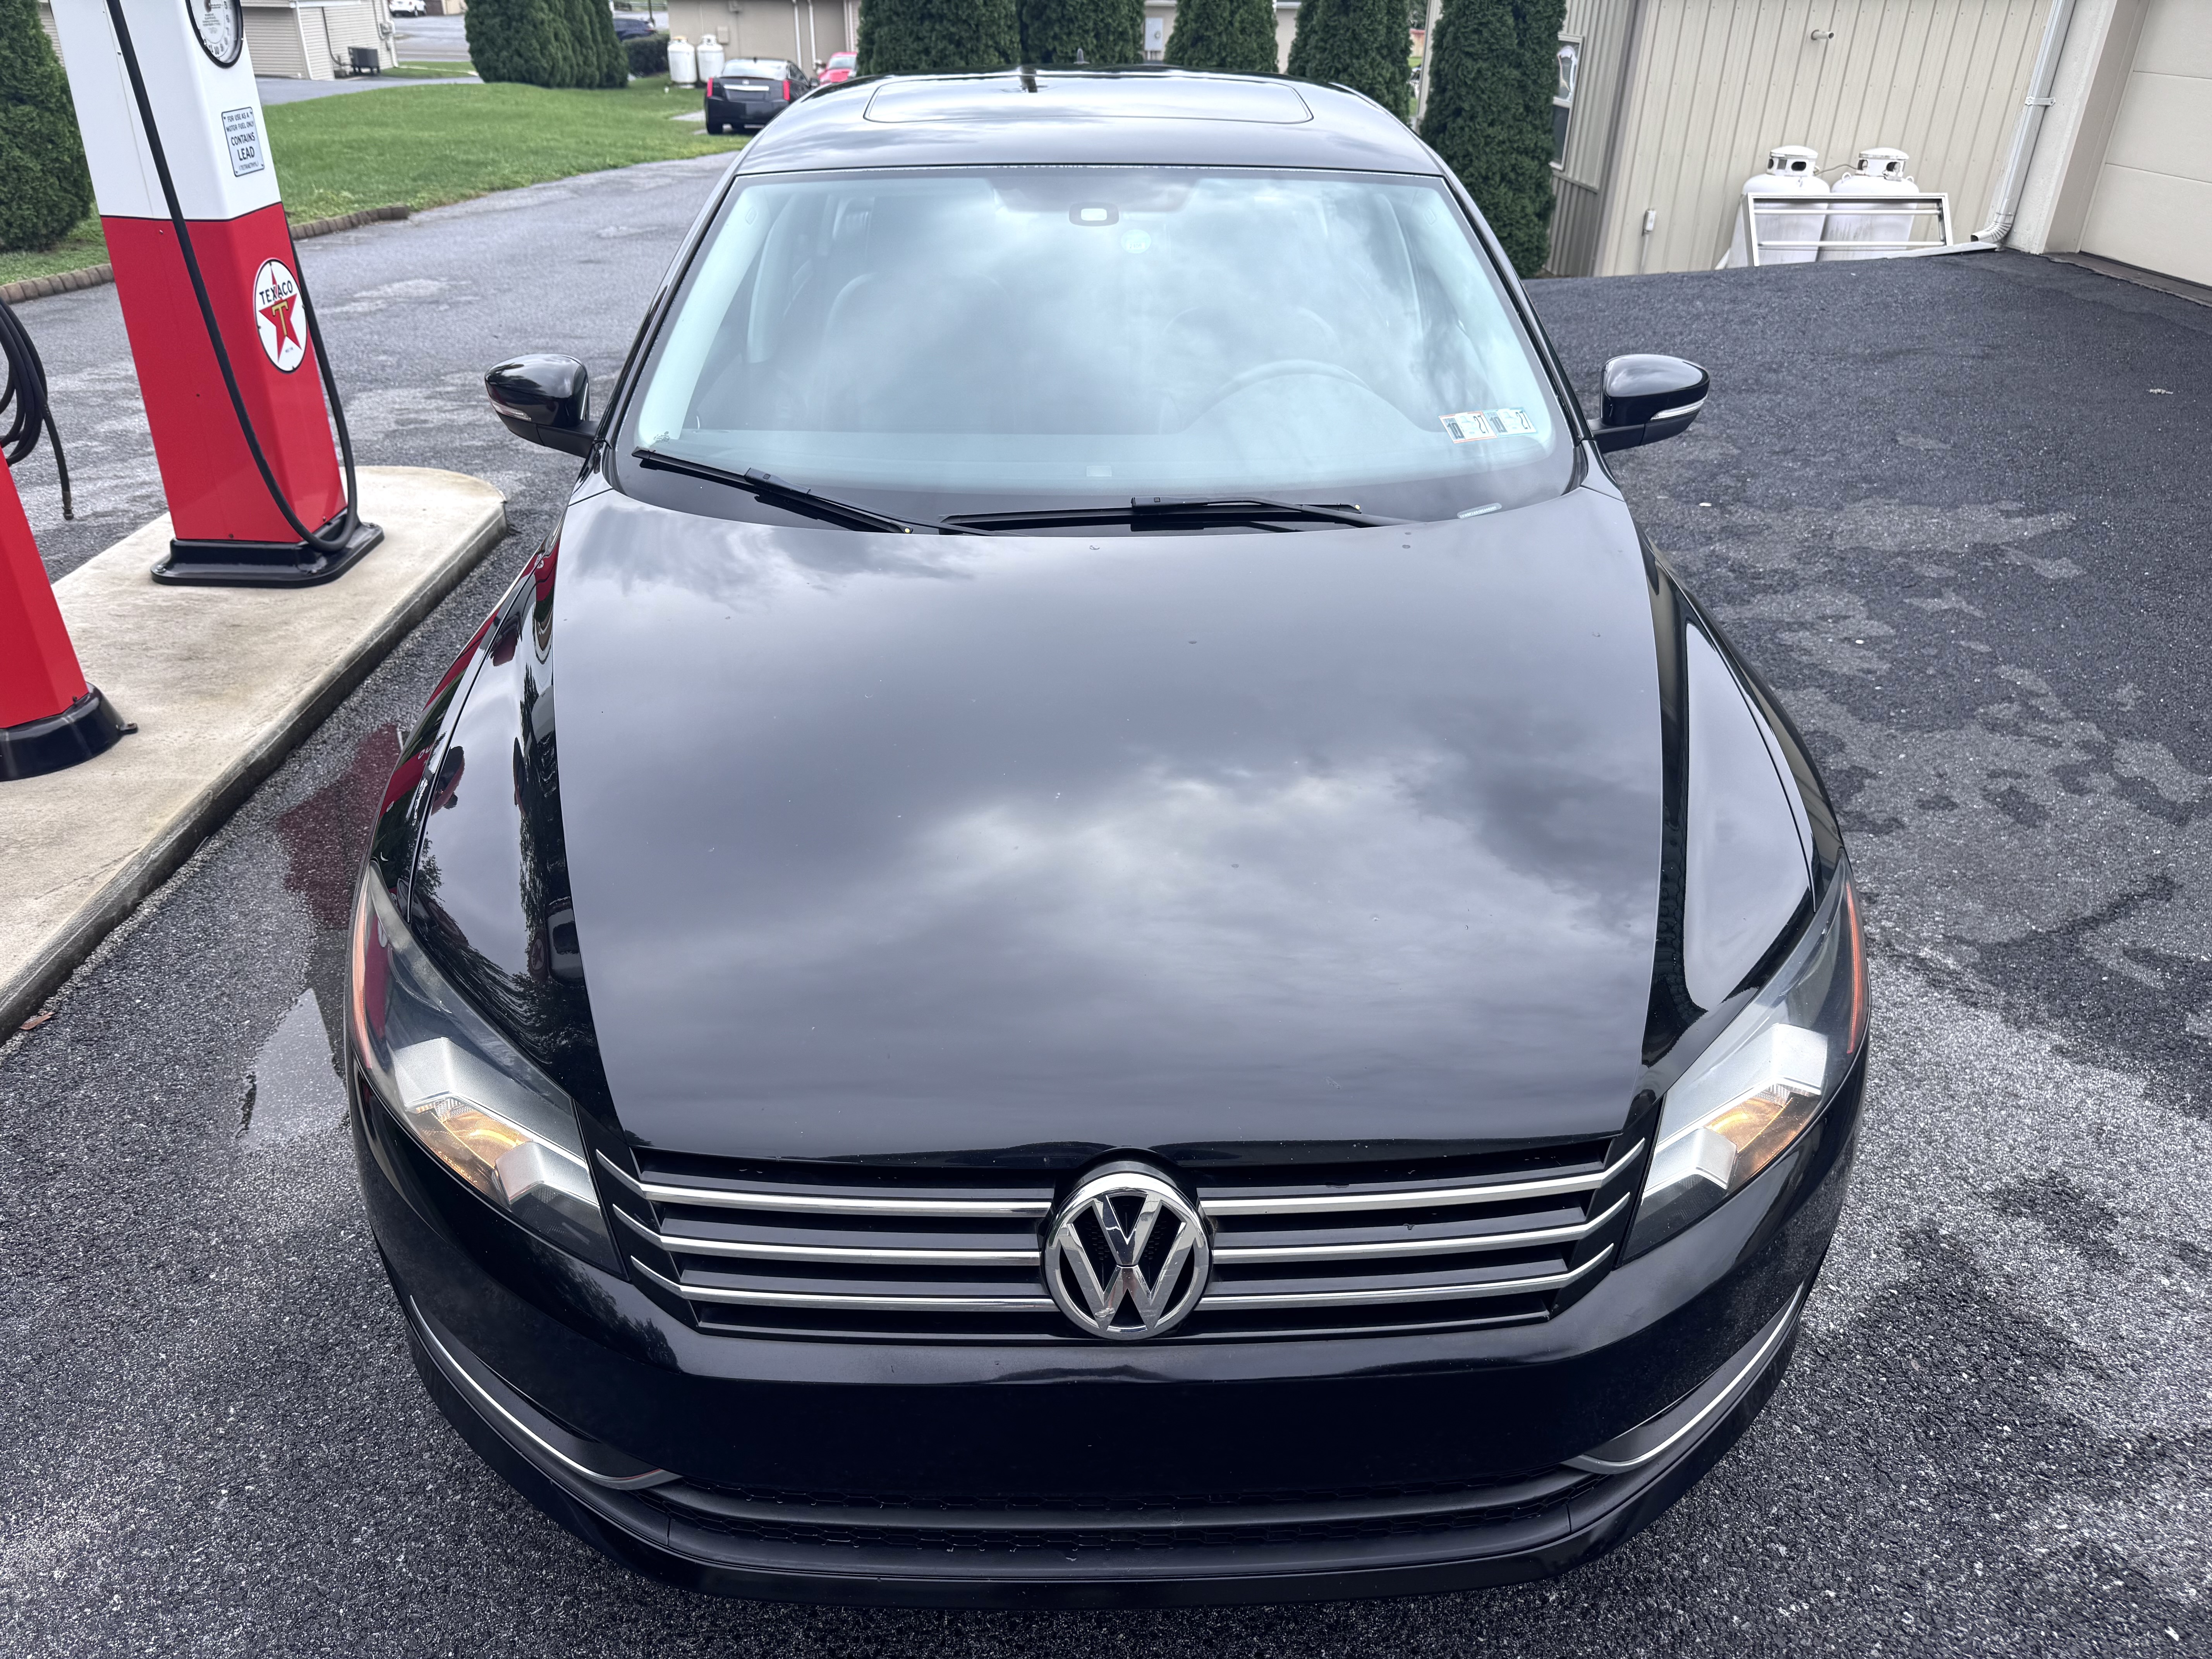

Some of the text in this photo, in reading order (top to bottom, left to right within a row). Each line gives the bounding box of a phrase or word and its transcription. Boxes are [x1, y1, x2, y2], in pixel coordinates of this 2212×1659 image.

[226, 124, 238, 132] MOTOR
[231, 132, 255, 146] CONTAINS
[237, 146, 255, 161] LEAD
[259, 280, 293, 305] TEXACO
[1447, 422, 1465, 440] 10
[1490, 417, 1508, 433] 10
